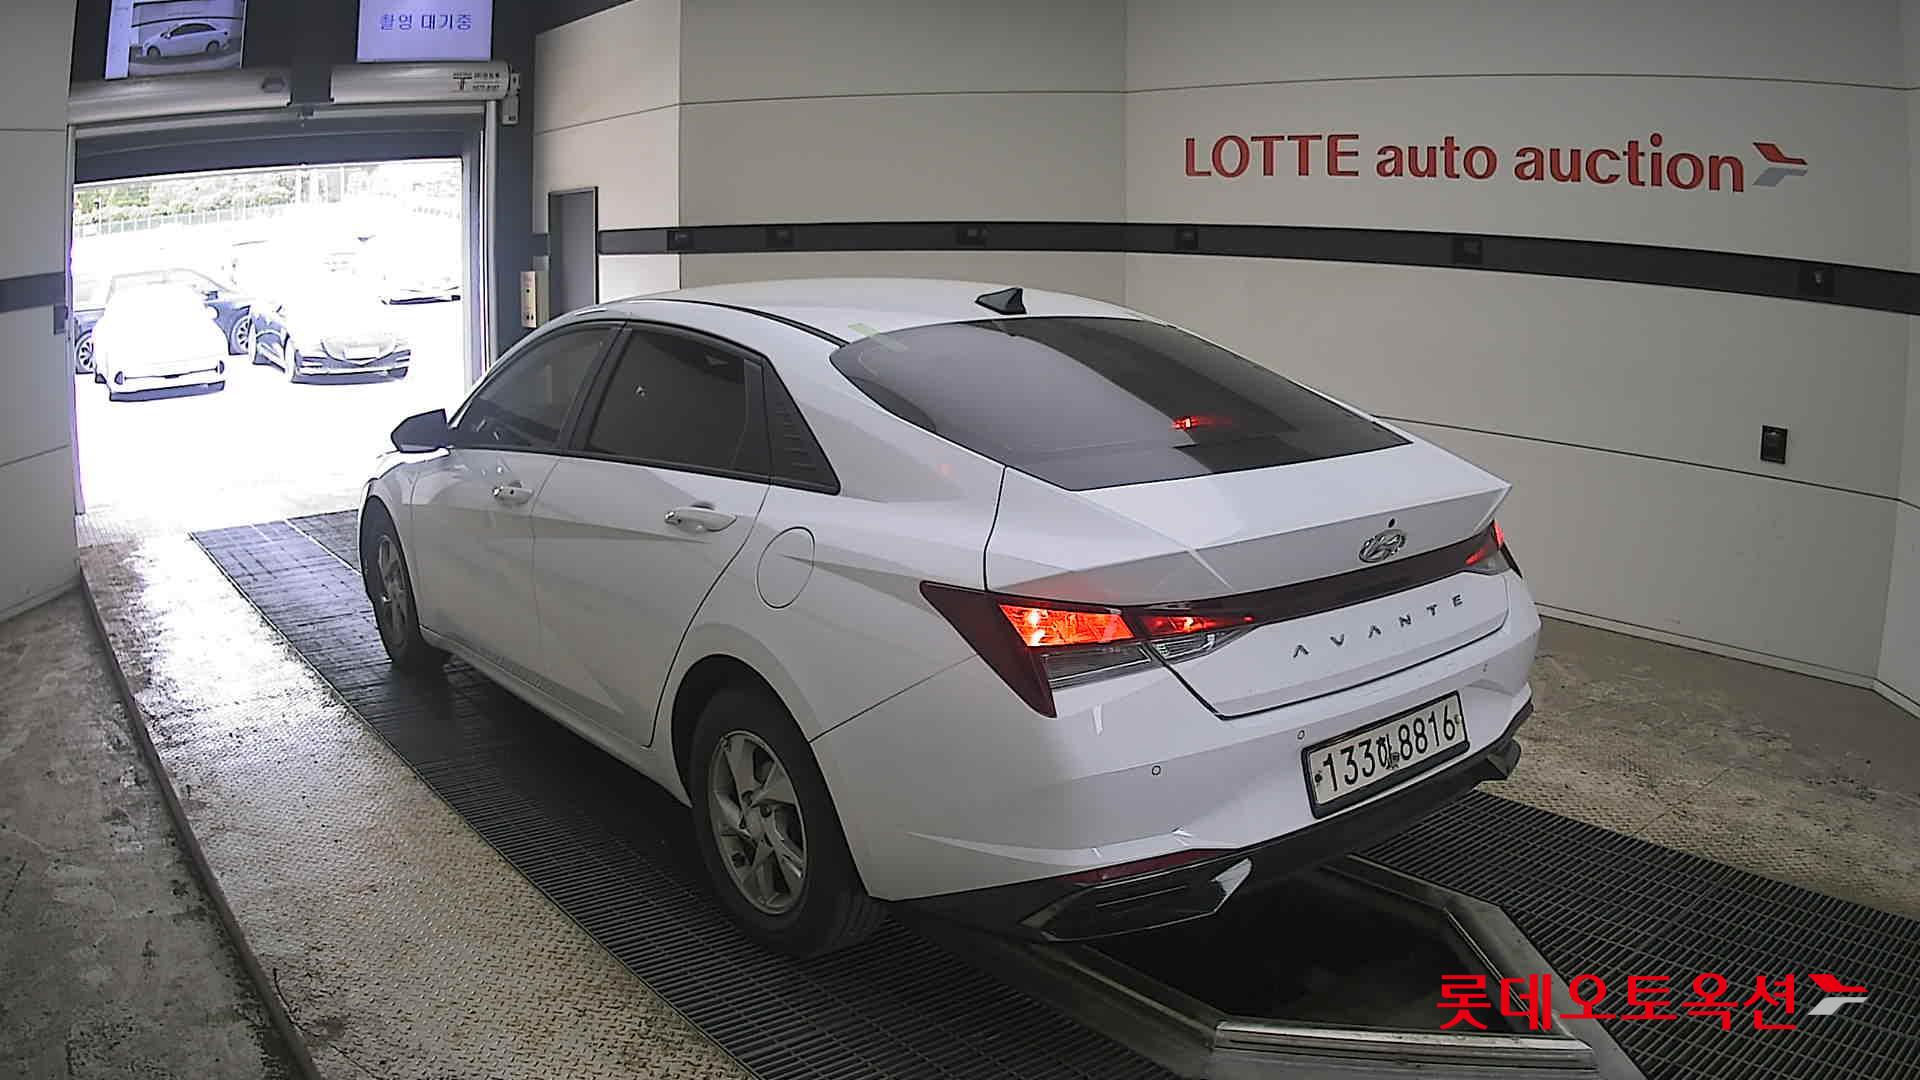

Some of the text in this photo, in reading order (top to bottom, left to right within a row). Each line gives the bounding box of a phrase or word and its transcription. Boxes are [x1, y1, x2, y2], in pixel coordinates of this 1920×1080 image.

[420, 13, 472, 31] 대기중
[1184, 134, 1745, 192] LOTTE auto auction
[1292, 594, 1464, 658] AVANTE
